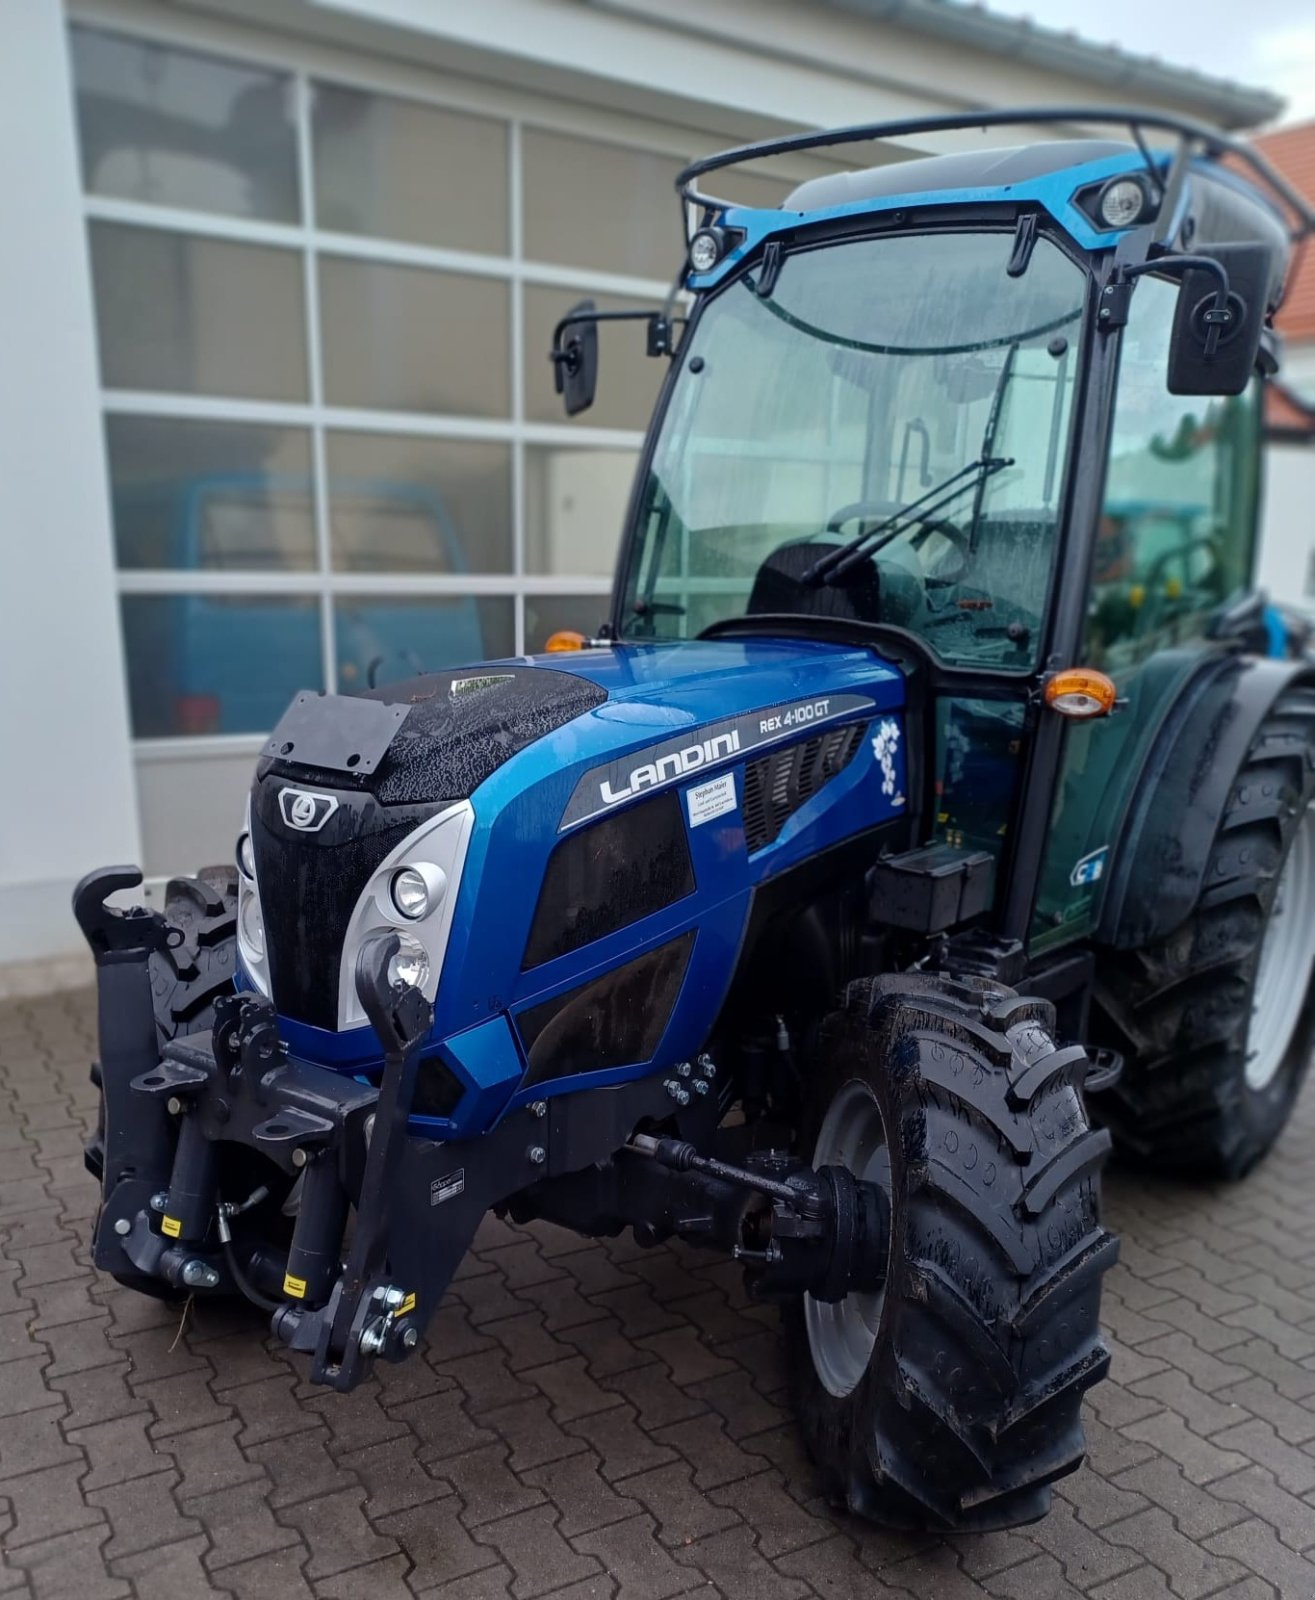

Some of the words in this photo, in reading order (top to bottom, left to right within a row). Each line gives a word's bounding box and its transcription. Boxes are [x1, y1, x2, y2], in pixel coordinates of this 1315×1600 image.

[760, 715, 782, 734] REX
[814, 699, 830, 717] GT
[599, 729, 740, 804] LANDINI
[695, 787, 714, 800] Stephan
